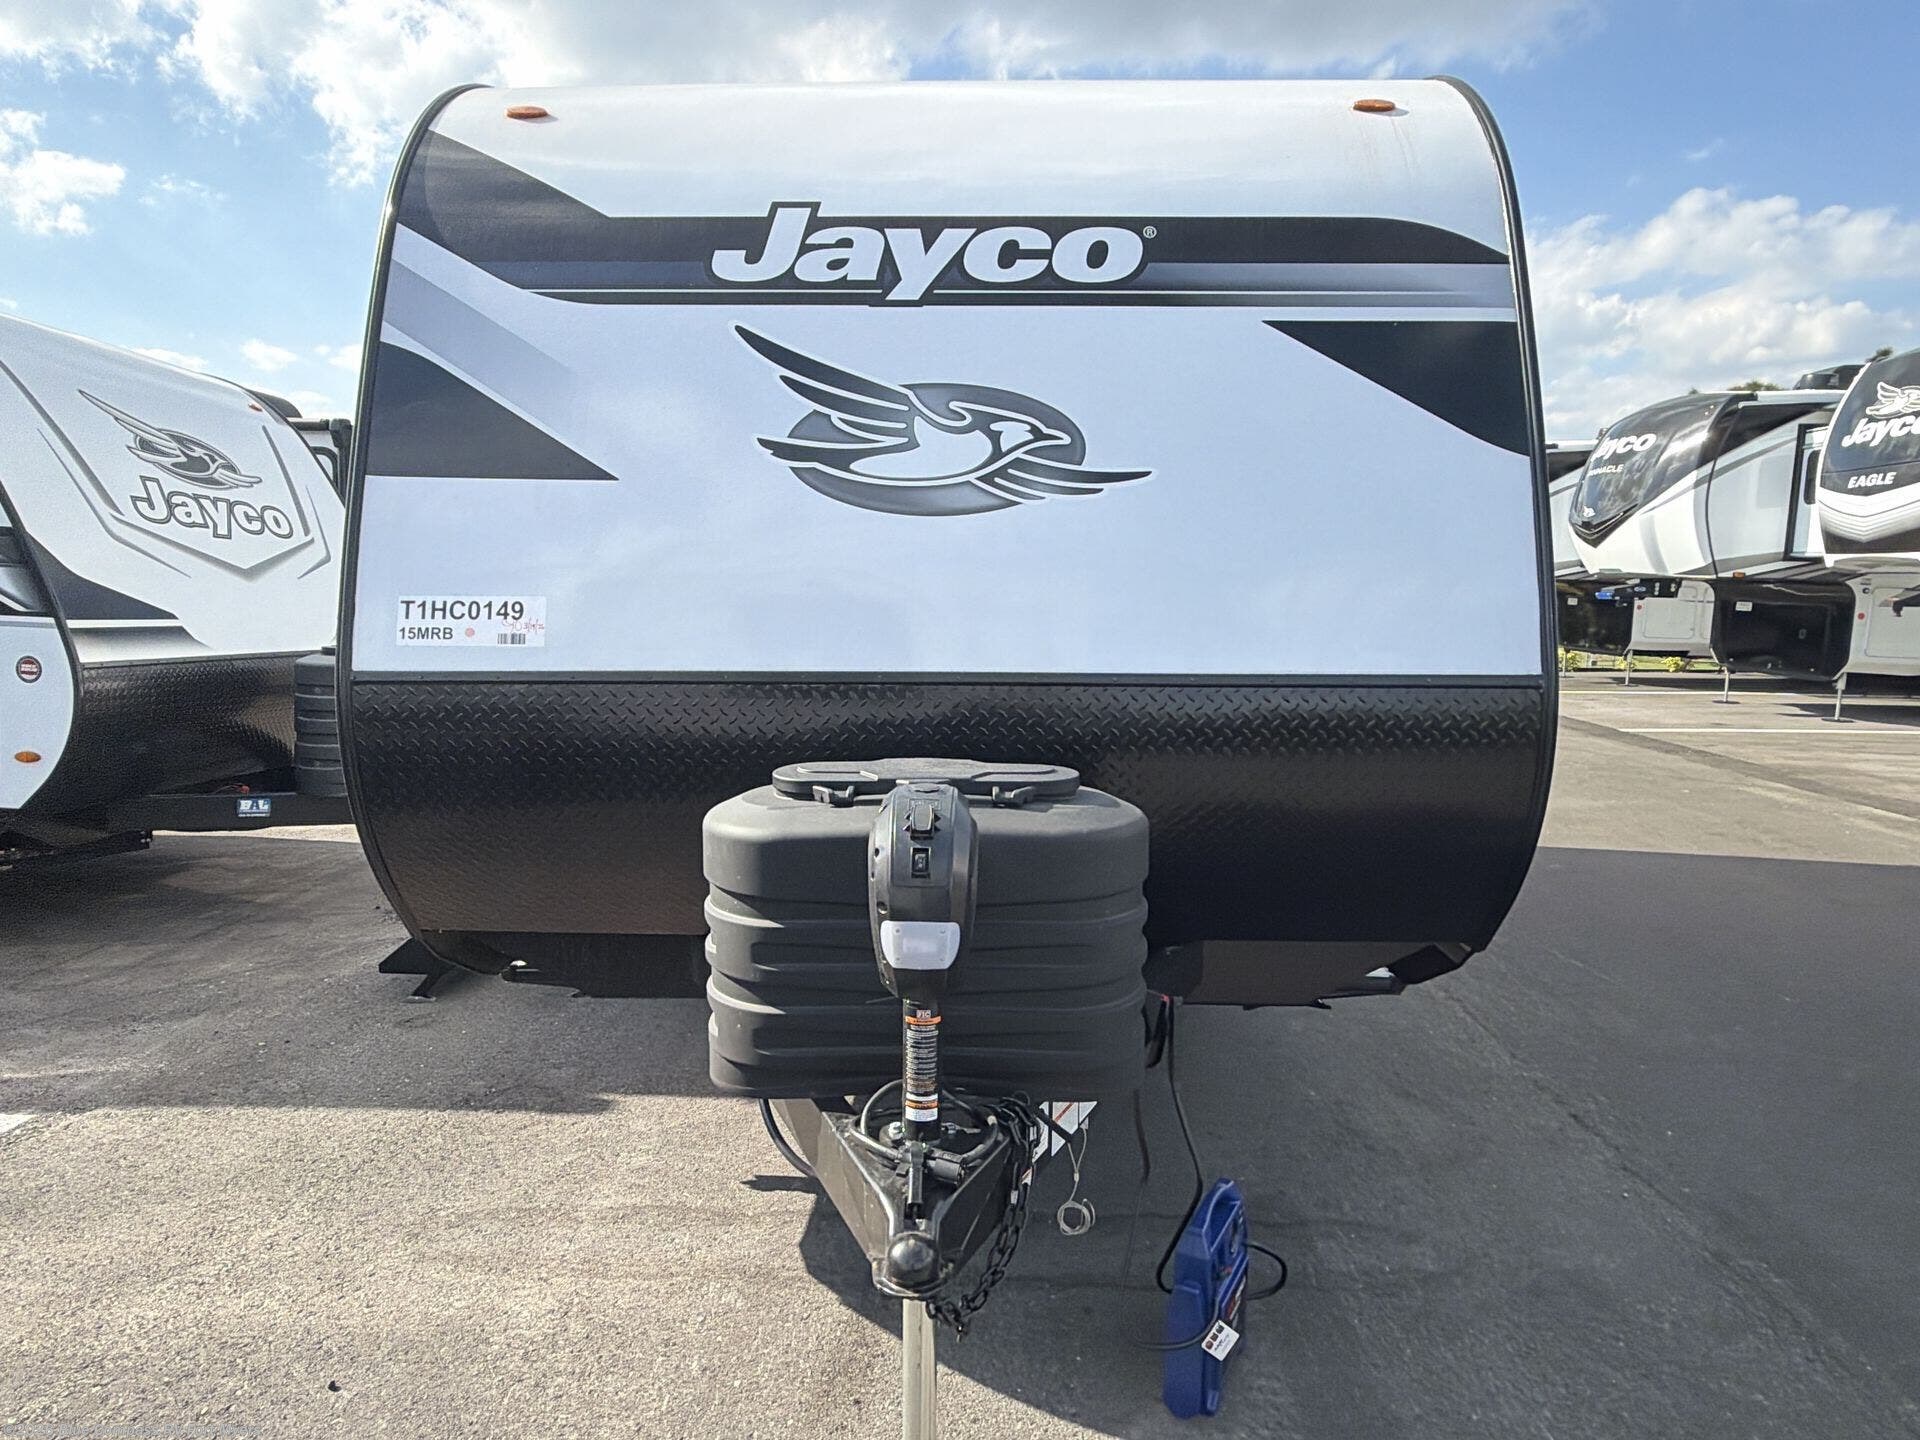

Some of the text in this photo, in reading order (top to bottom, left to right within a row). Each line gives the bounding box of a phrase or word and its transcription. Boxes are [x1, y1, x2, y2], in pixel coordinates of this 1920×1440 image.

[1587, 464, 1624, 477] NACLE
[1847, 472, 1897, 489] EAGLE
[130, 475, 293, 539] Jayco
[400, 600, 524, 621] T1HC0149
[399, 627, 454, 640] 15MRB
